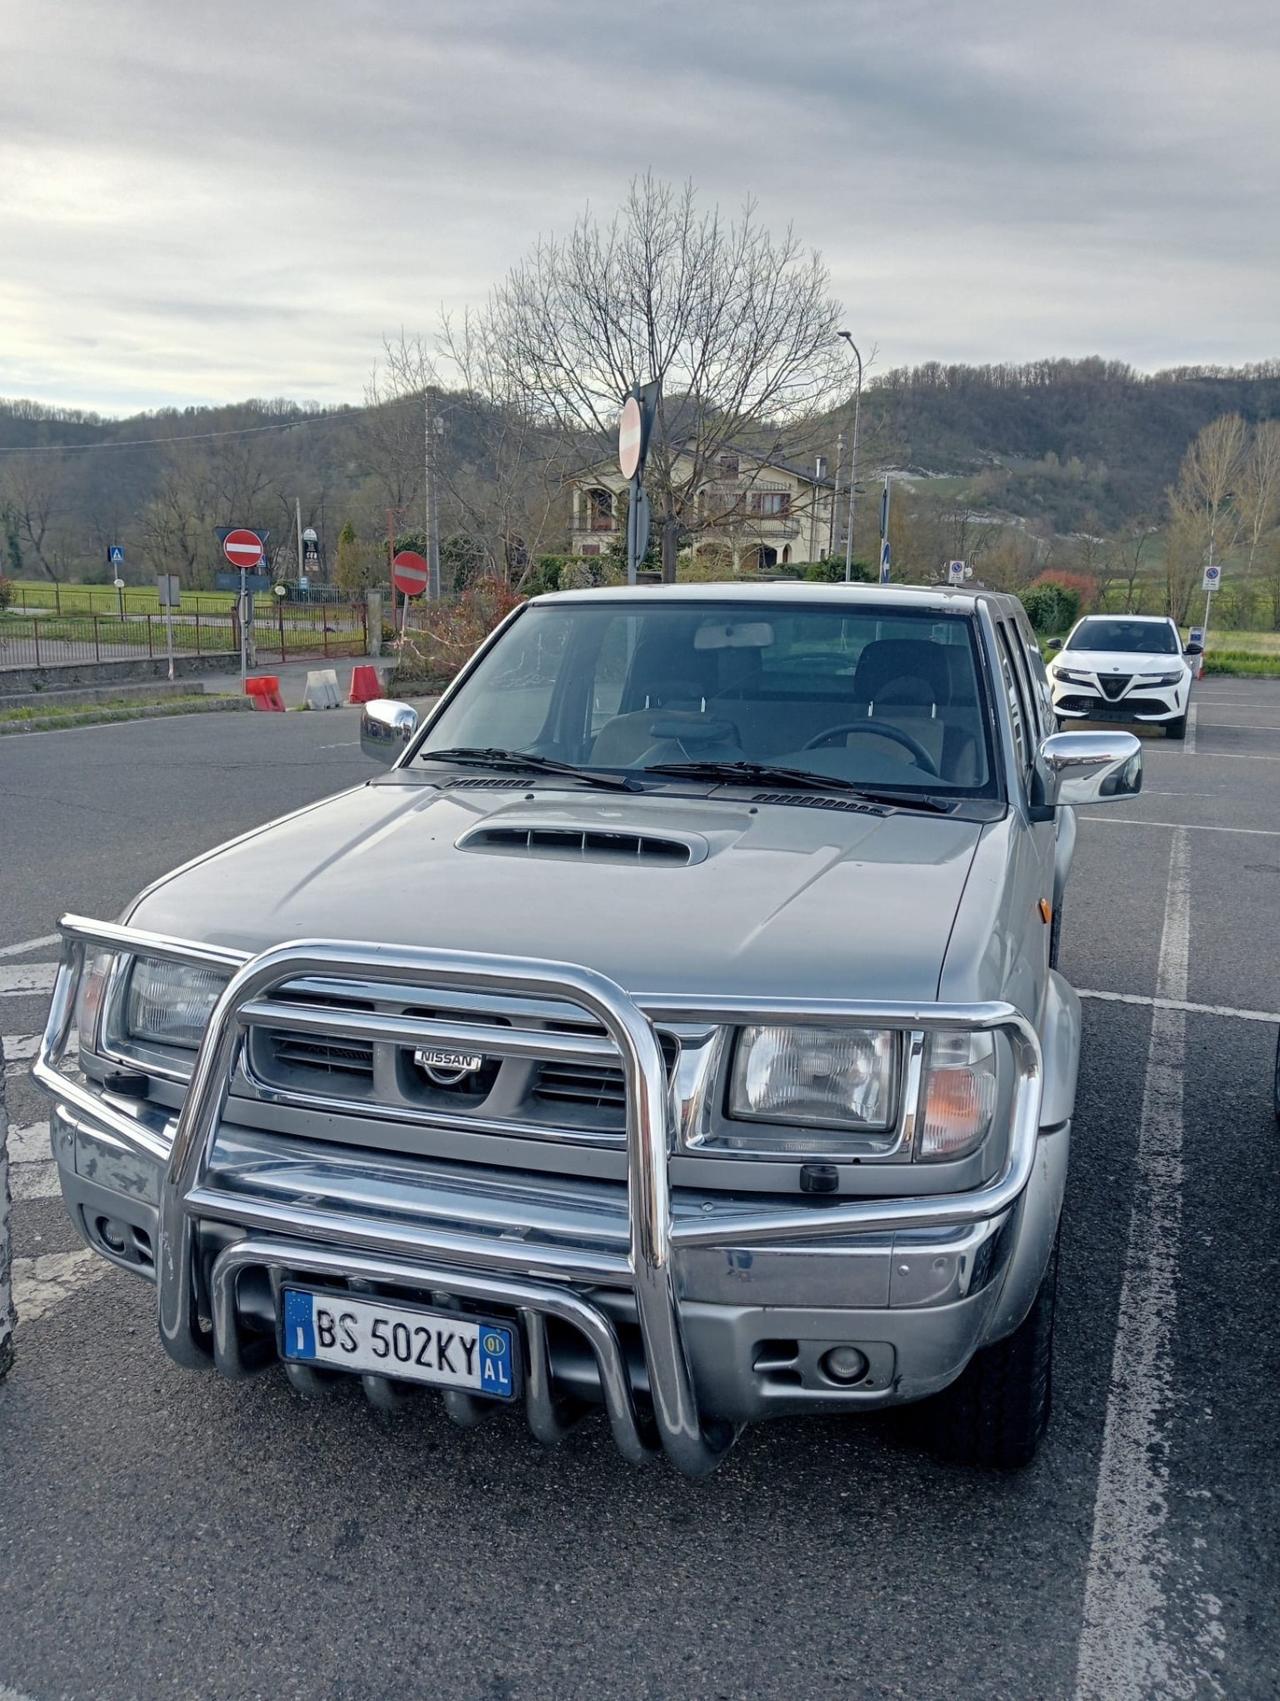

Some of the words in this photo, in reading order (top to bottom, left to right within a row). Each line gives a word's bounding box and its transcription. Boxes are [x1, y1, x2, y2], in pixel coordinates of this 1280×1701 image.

[421, 1051, 473, 1067] NISSAN
[316, 1309, 358, 1353] BS
[371, 1318, 479, 1376] 502KY
[484, 1358, 509, 1384] AL
